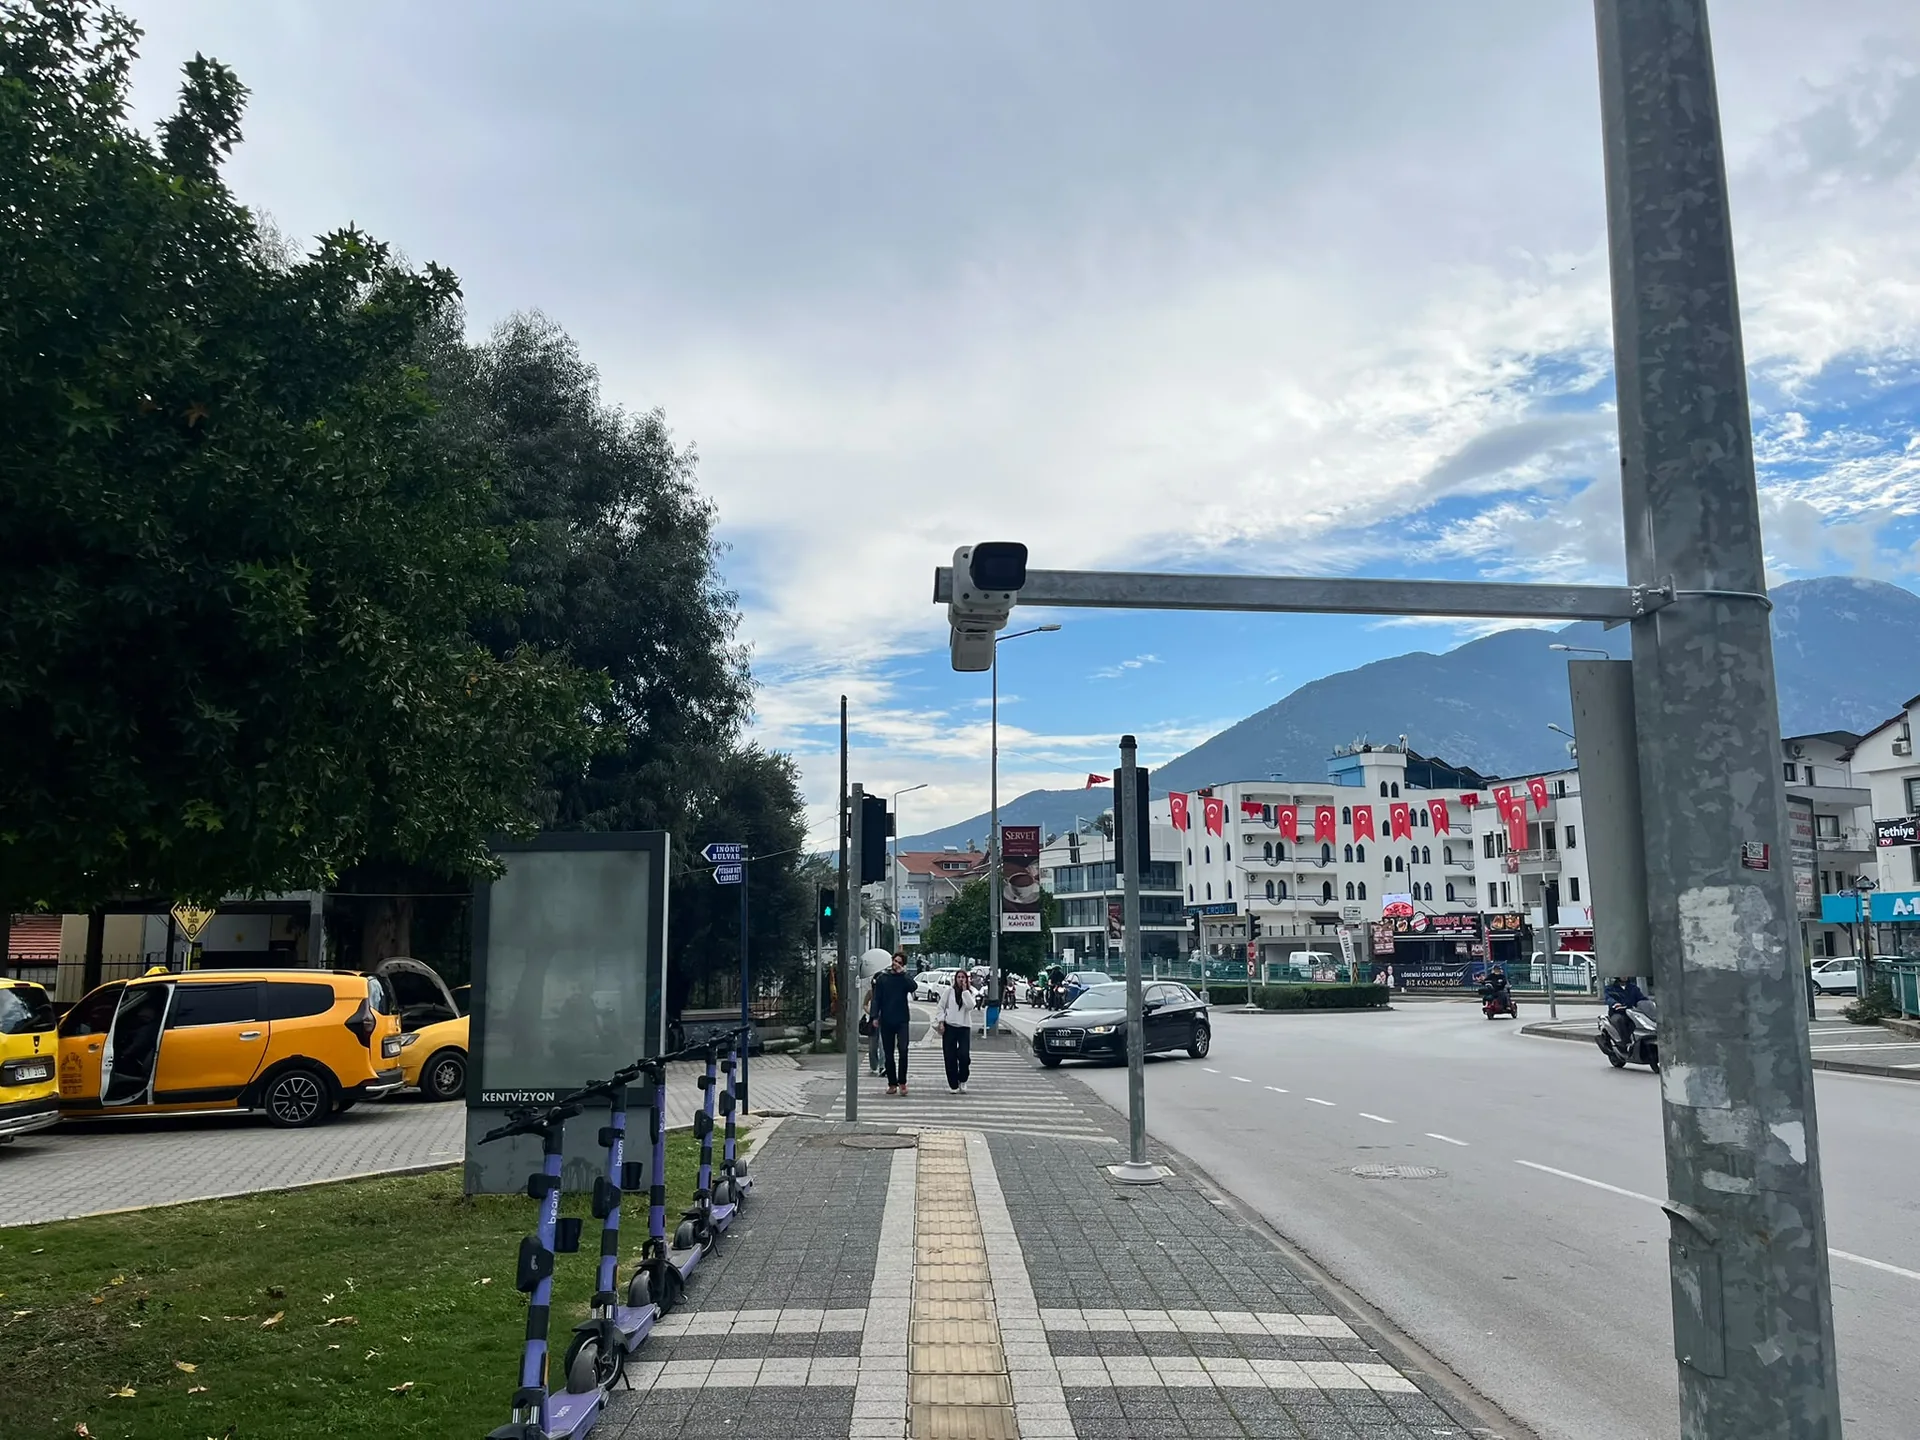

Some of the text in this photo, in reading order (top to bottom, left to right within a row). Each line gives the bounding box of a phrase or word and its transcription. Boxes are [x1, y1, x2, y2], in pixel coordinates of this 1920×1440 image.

[1005, 831, 1036, 841] SERVET
[1878, 826, 1915, 839] Fethiye
[716, 844, 740, 853] İNÖNÜ
[1207, 905, 1233, 914] EROĞLU
[482, 1089, 555, 1102] KENTVİZYON
[615, 1140, 624, 1167] beam
[548, 1190, 560, 1225] beam
